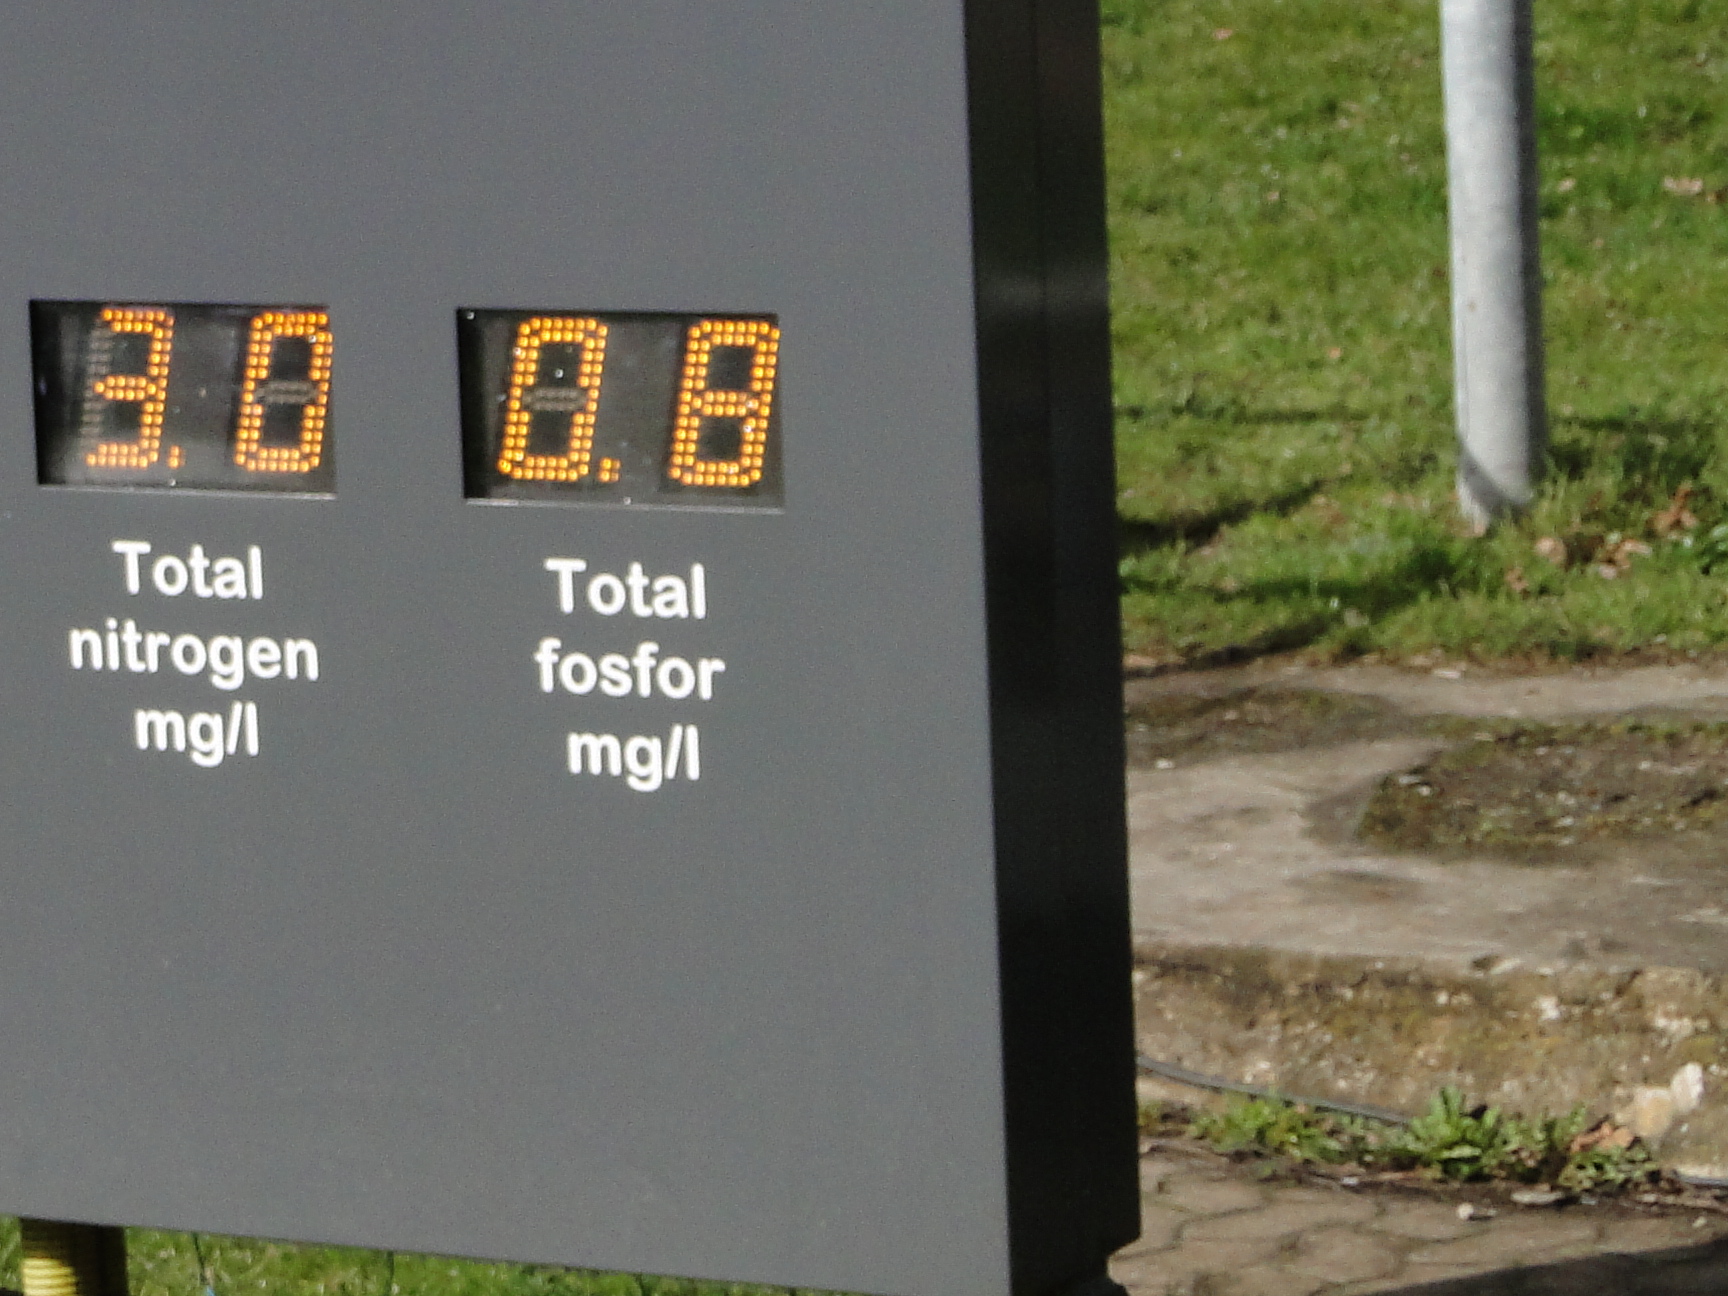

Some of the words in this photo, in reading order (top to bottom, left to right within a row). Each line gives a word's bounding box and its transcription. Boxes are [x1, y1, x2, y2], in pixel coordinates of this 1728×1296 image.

[113, 540, 263, 599] Total
[545, 558, 706, 619] Total
[69, 618, 319, 691] nitrogen
[535, 642, 724, 701] fosfor
[135, 701, 259, 767] mg/l
[567, 724, 701, 791] mg/l
